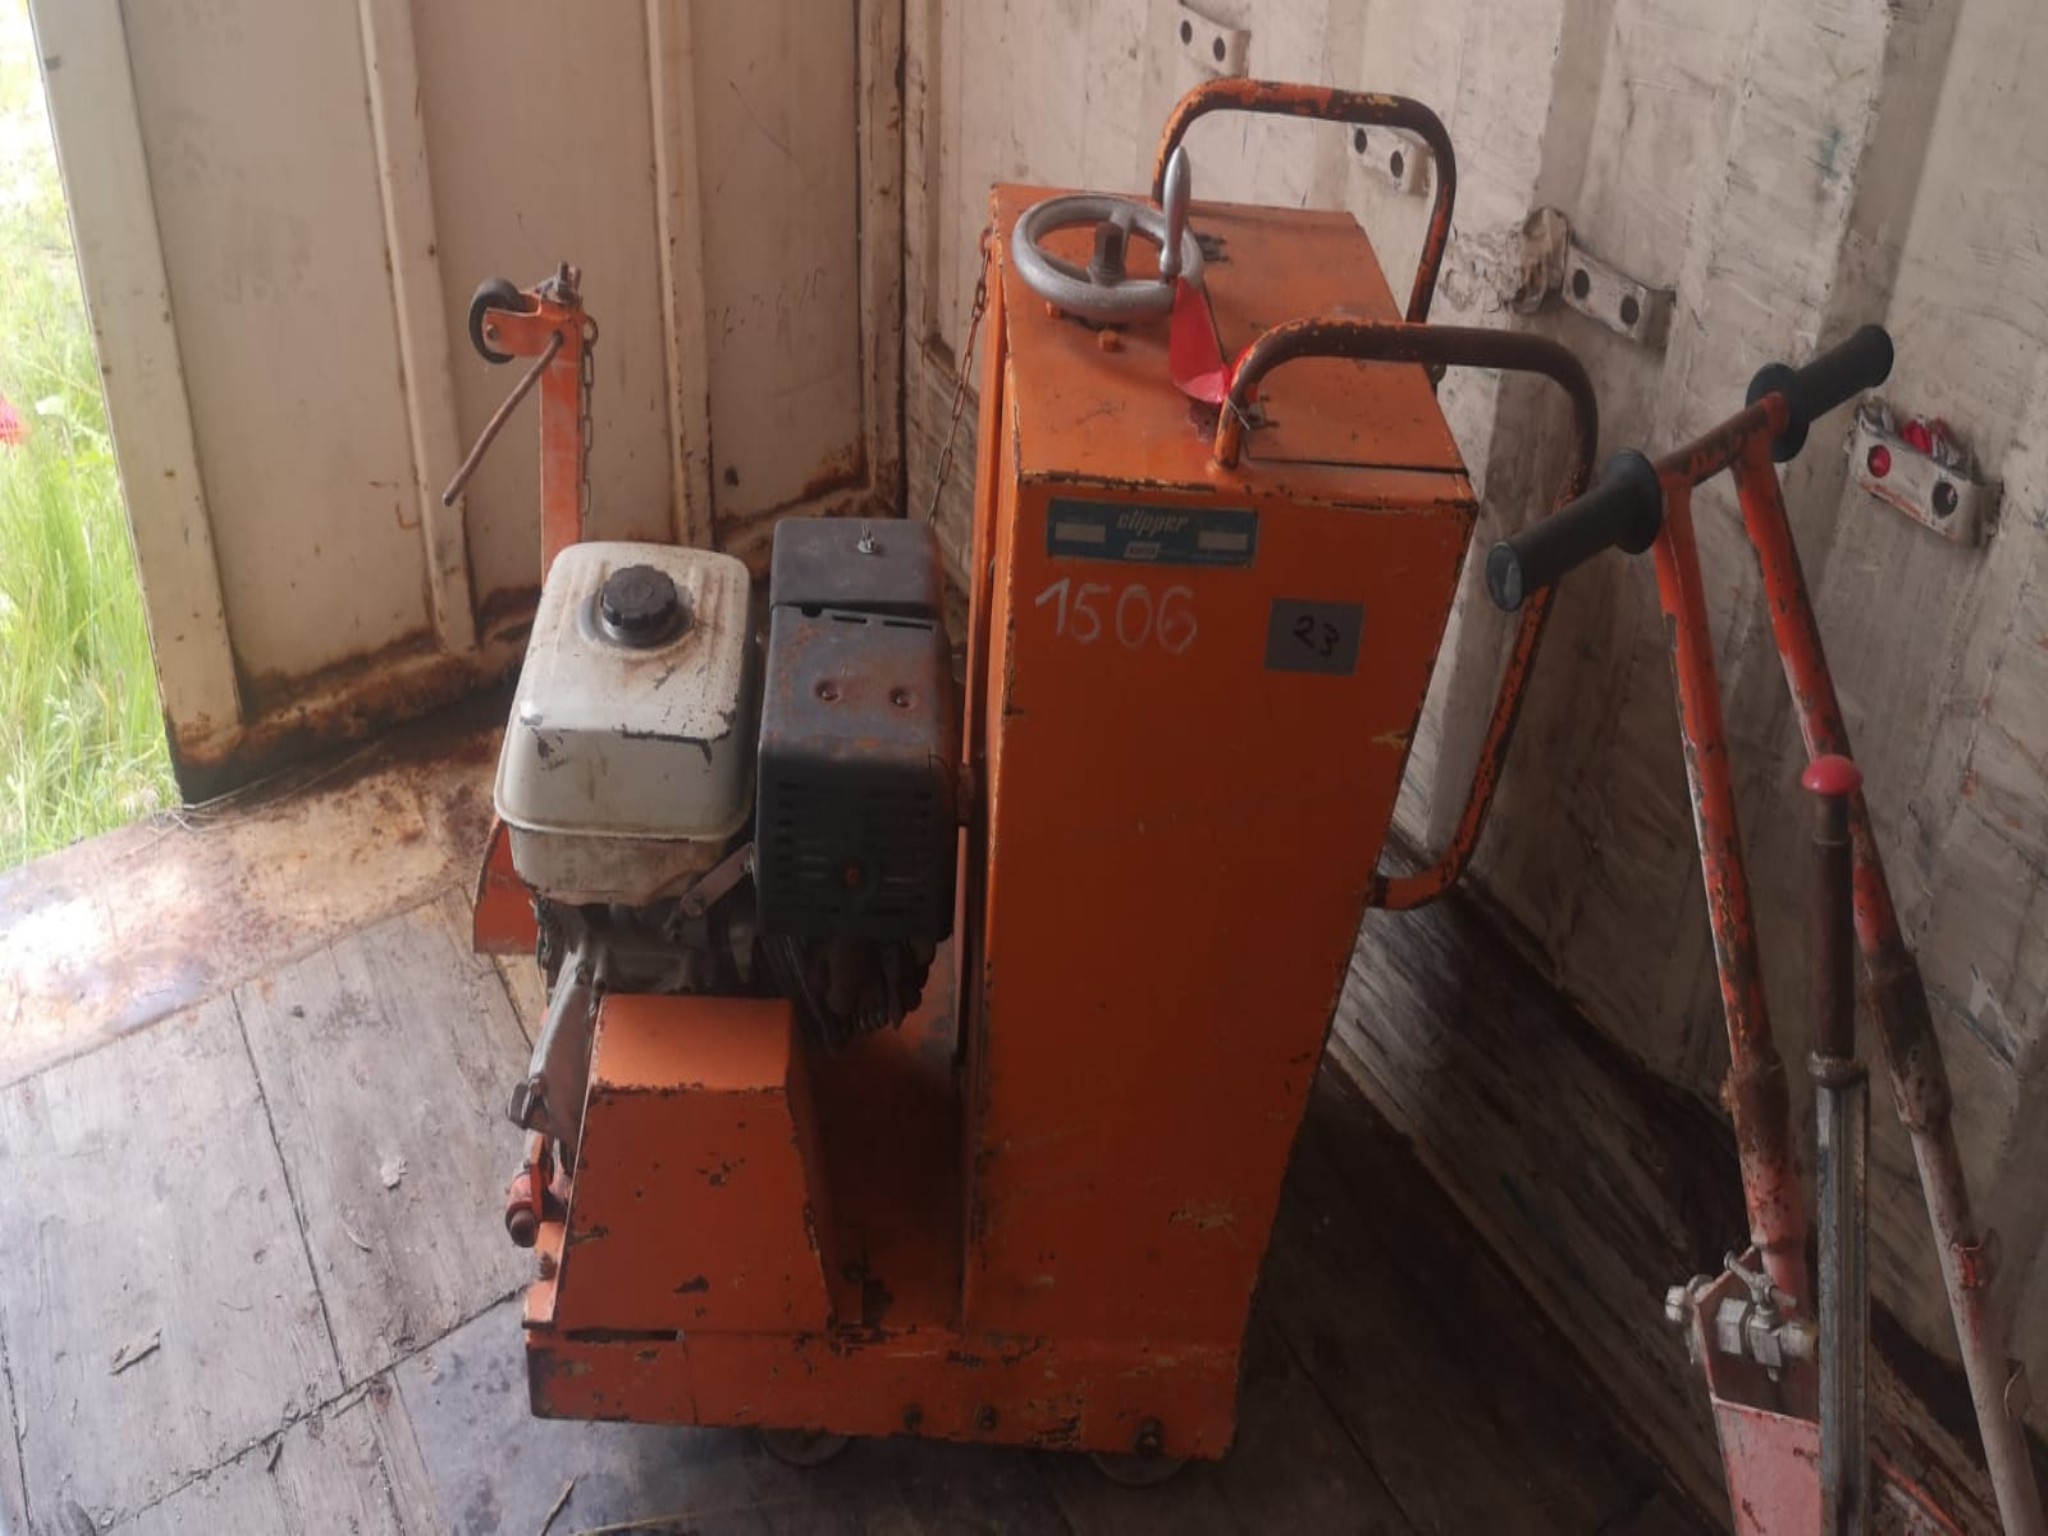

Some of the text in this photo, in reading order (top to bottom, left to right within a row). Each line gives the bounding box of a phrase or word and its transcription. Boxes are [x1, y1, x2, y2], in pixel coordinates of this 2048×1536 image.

[1116, 508, 1189, 538] clipper
[1034, 577, 1198, 654] 1506
[1293, 614, 1341, 657] 23
